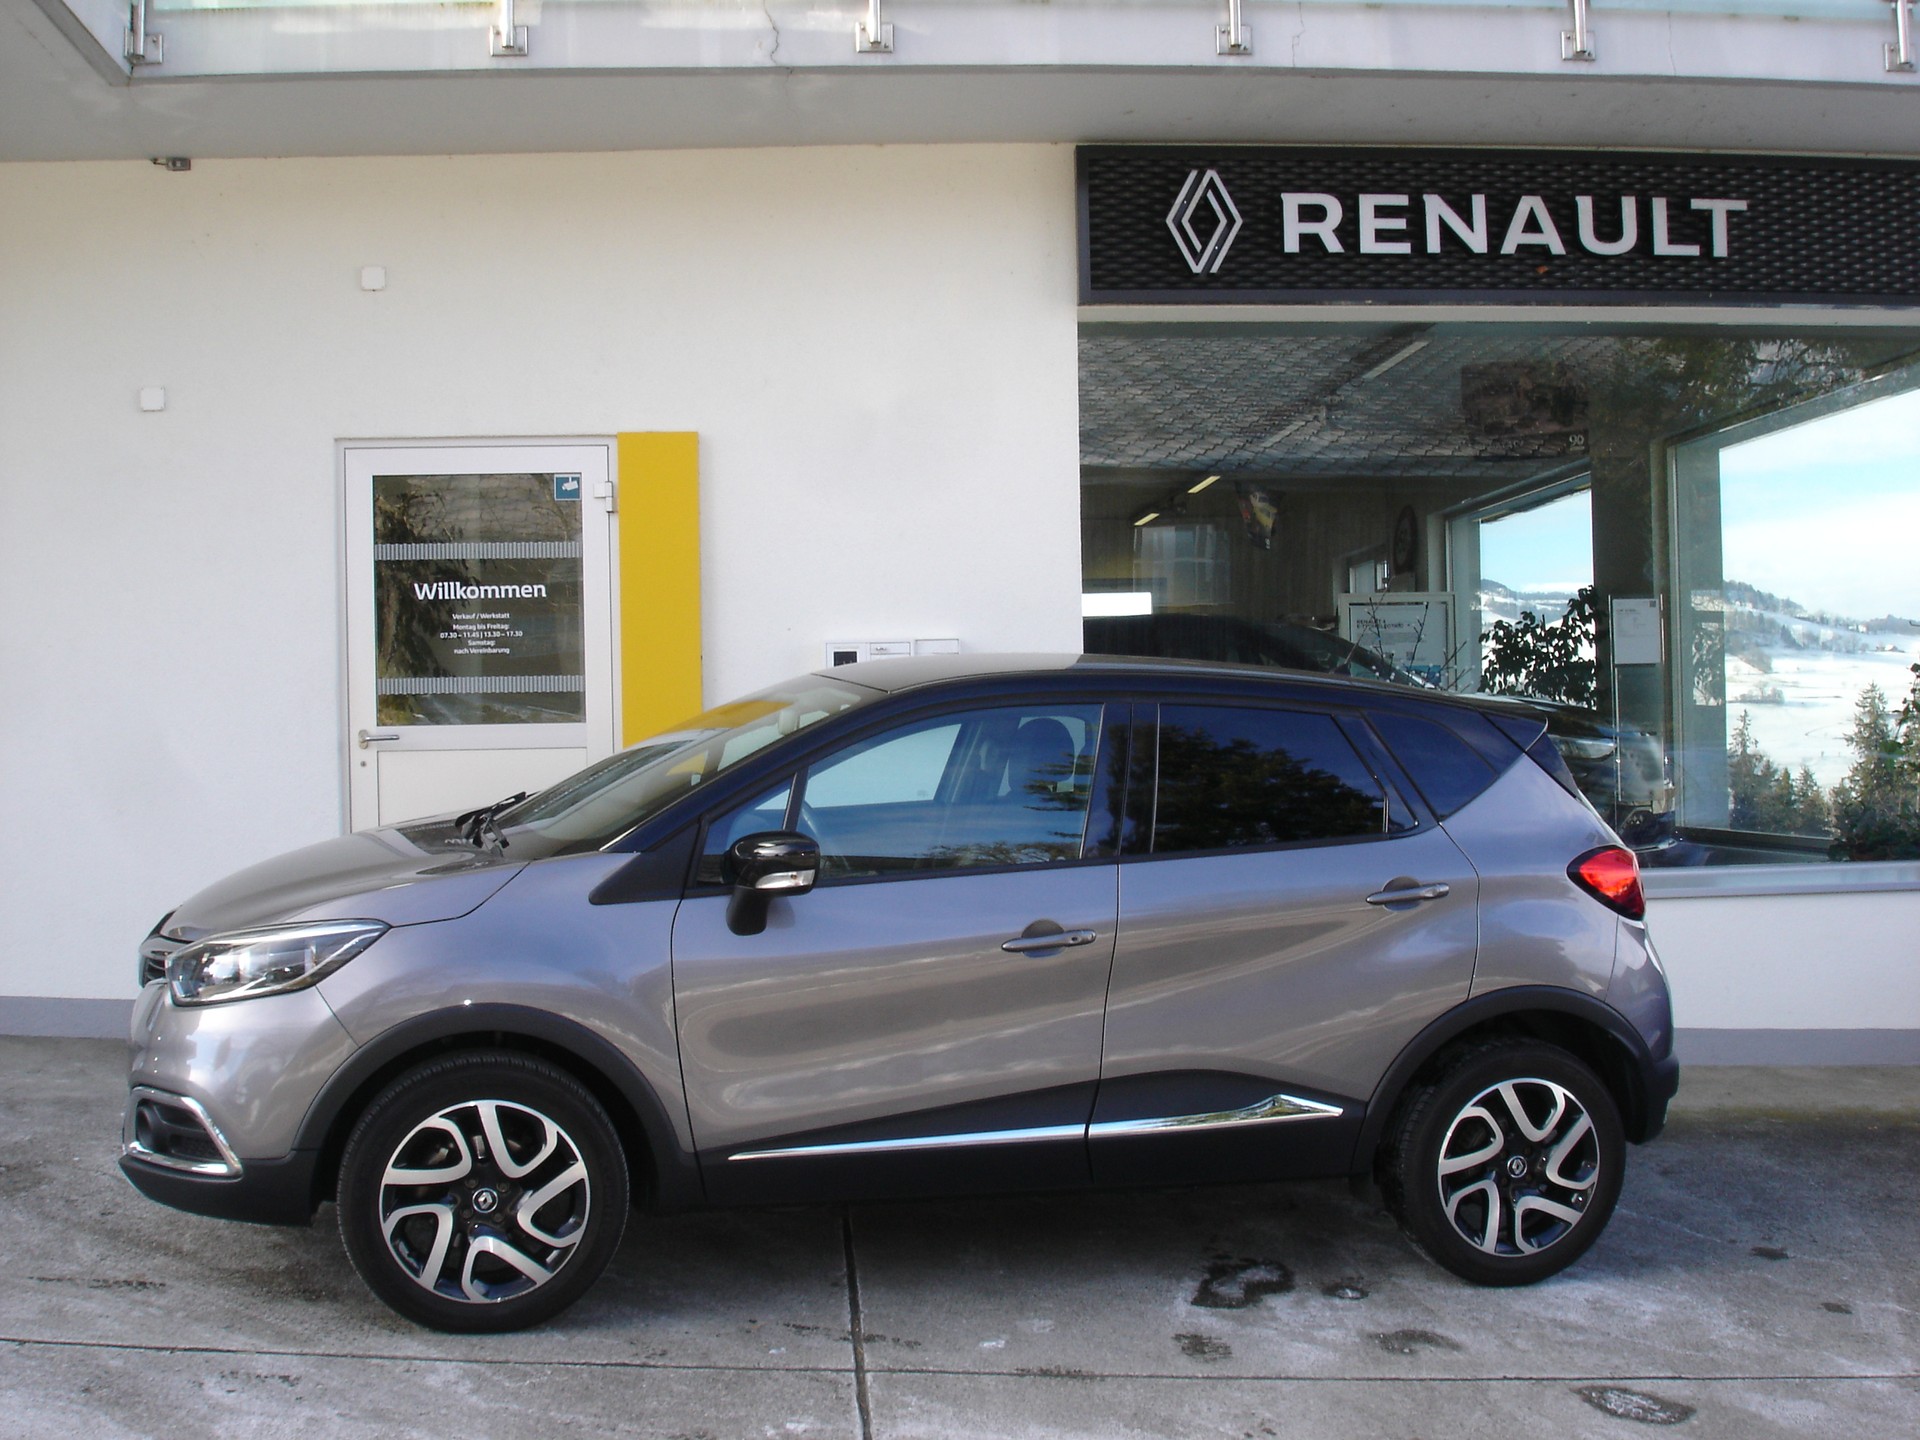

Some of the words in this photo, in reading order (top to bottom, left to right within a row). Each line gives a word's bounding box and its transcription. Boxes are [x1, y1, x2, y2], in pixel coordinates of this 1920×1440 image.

[1281, 193, 1747, 257] RENAULT
[414, 582, 547, 600] Willkommen
[470, 647, 510, 655] Vereinbarung
